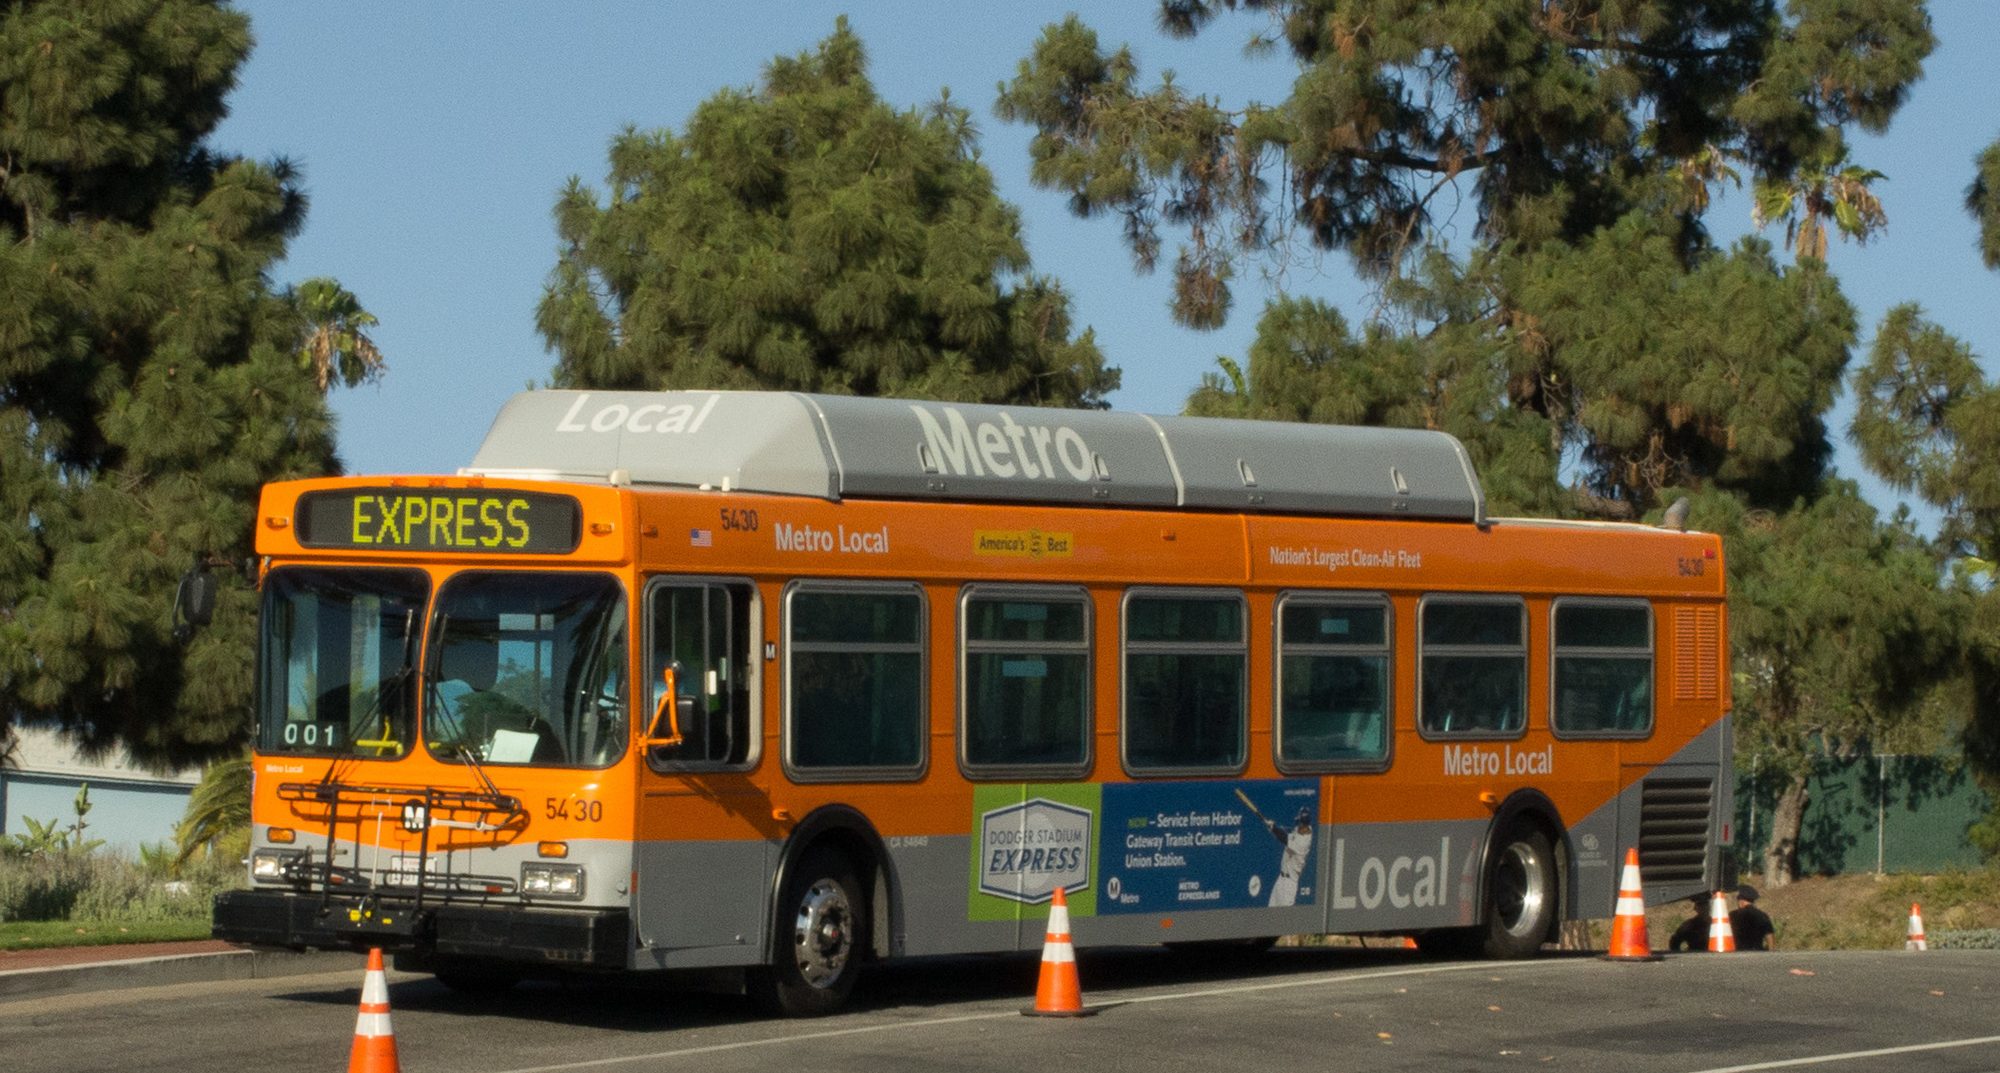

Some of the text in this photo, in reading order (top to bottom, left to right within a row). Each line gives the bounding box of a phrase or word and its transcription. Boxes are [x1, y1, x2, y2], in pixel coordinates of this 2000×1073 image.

[556, 394, 720, 434] Local
[910, 405, 1094, 481] Metro
[352, 495, 531, 548] EXPRESS
[720, 508, 759, 532] 5430
[774, 522, 889, 554] Metro Local
[979, 534, 1026, 552] America's
[1047, 537, 1068, 553] Best
[1269, 547, 1421, 572] Nation's Largest Clean-Air Fleet
[284, 723, 334, 746] 001
[1443, 744, 1553, 776] Metro Local
[545, 797, 603, 823] 5430
[1157, 813, 1188, 828] Service
[1190, 811, 1210, 826] from
[1212, 810, 1242, 825] Harbor
[990, 828, 1083, 845] DODGER STADIUM
[1126, 830, 1241, 850] Gateway Transit Center and
[989, 847, 1082, 874] EXPRESS
[1125, 852, 1186, 868] Union Station.
[1333, 836, 1450, 910] Local
